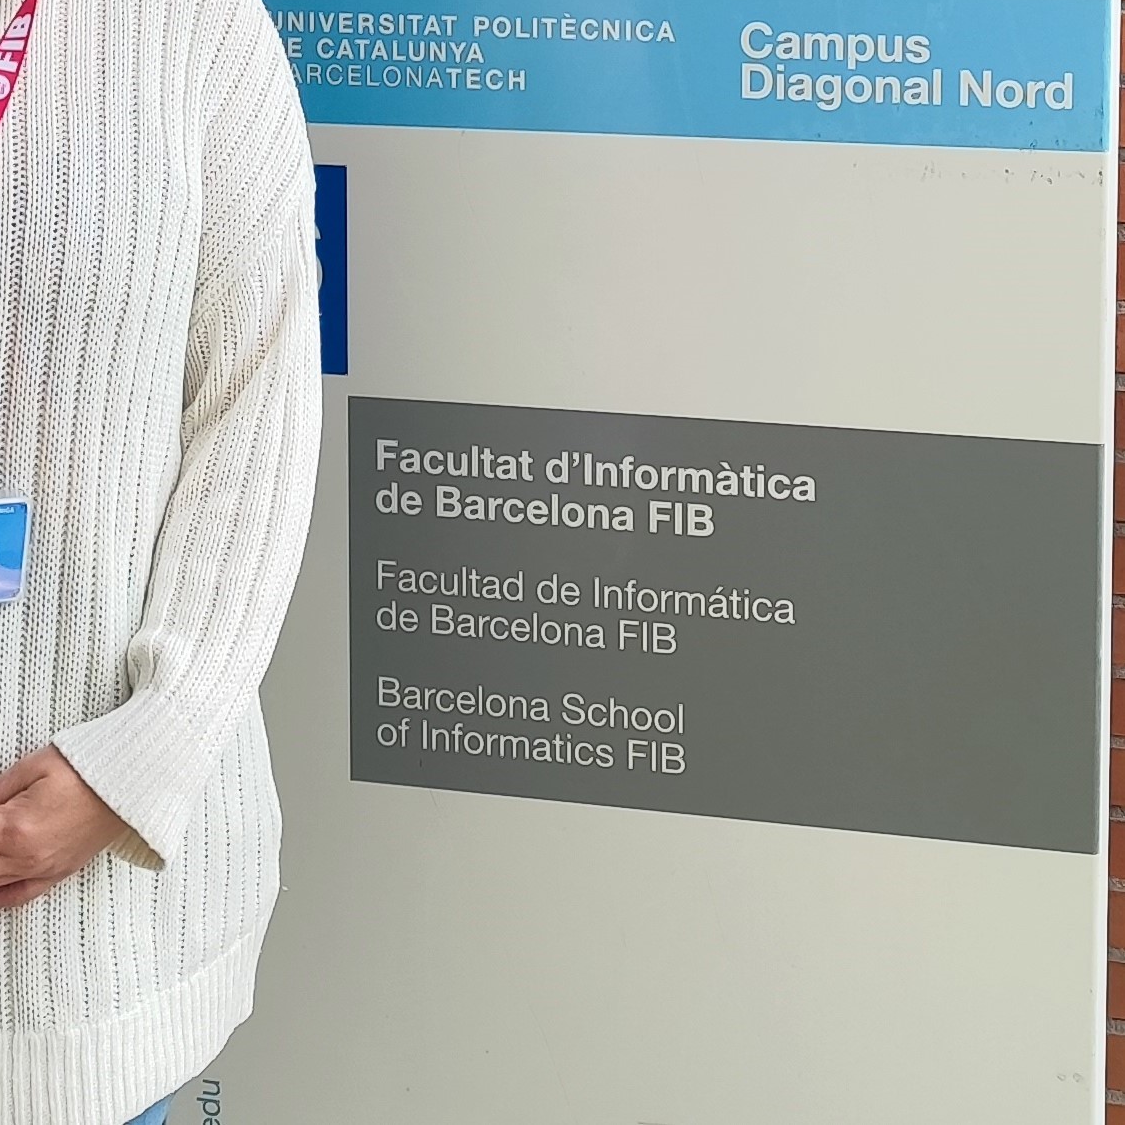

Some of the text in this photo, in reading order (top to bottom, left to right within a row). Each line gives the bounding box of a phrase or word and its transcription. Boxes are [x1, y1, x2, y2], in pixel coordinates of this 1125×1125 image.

[317, 38, 485, 64] CATALUNYA
[474, 13, 676, 42] POLITÈCNICA
[740, 21, 931, 71] Campus
[292, 63, 526, 91] ARCELONATECH
[740, 63, 1074, 112] Diagonal Nord
[376, 438, 534, 482] Facultat
[376, 482, 715, 537] de Barcelona FIB
[376, 560, 796, 624] Facultad de Informática
[376, 601, 678, 654] de Barcelona FIB
[377, 676, 685, 735] Barcelona School
[377, 719, 686, 774] of Informatics FIB
